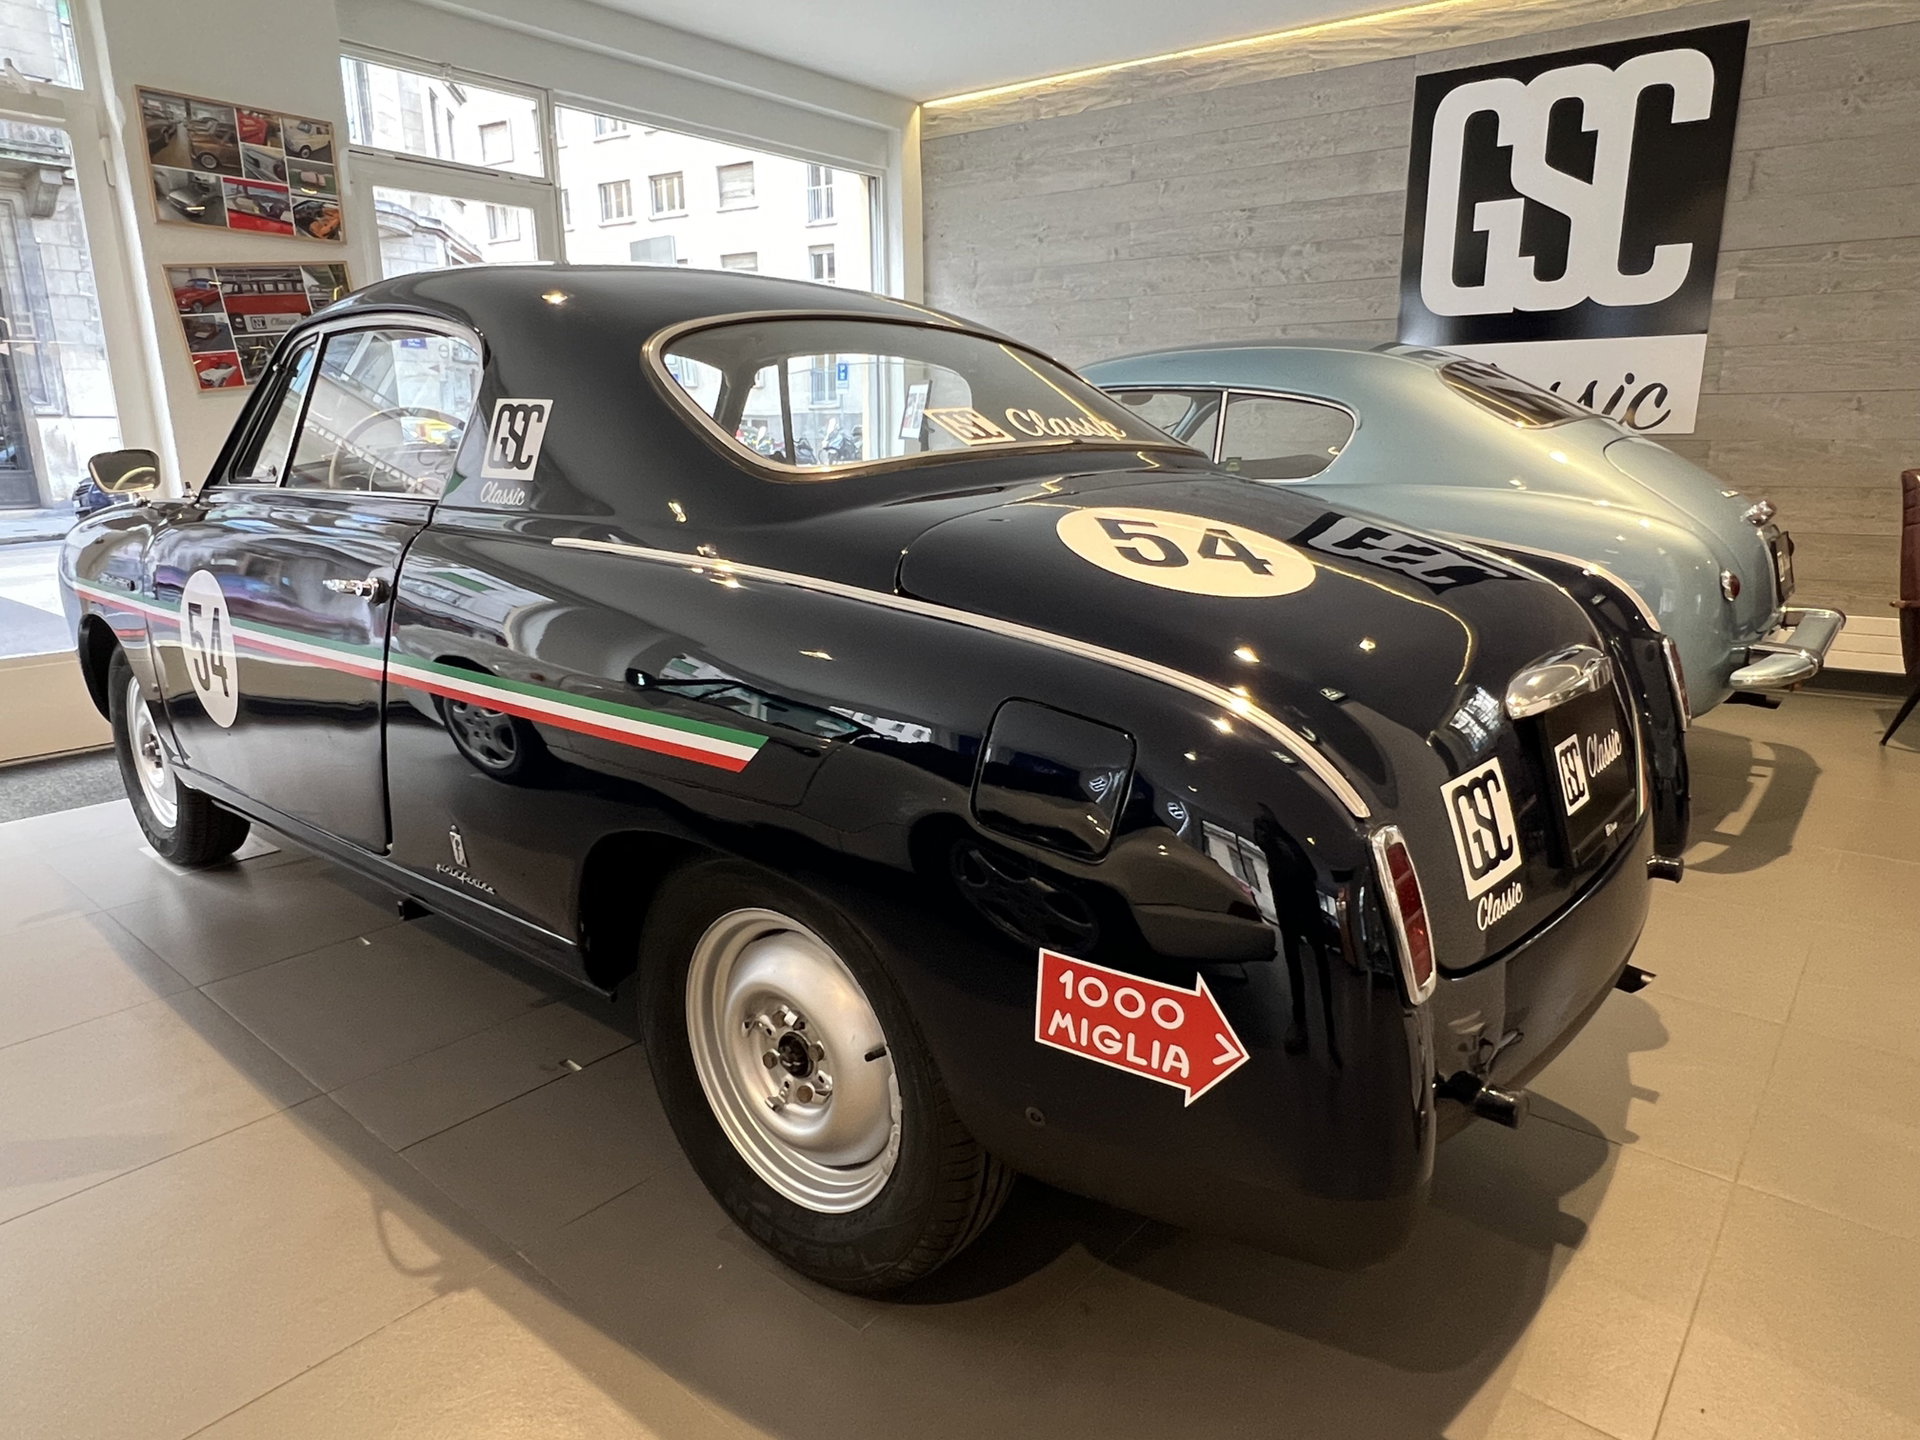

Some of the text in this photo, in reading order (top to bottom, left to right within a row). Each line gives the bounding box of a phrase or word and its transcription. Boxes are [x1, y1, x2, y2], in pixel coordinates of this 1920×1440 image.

[1421, 48, 1715, 316] GSC
[488, 404, 544, 470] GSC
[1005, 408, 1127, 441] Classic
[480, 481, 525, 506] Classic
[1094, 516, 1275, 578] 54
[188, 602, 229, 697] 54
[1559, 728, 1622, 808] GSC Classic
[1451, 768, 1513, 881] GSC
[1477, 882, 1524, 932] Classic
[1059, 969, 1185, 1030] 1000
[1047, 1009, 1190, 1079] MIGLIA
